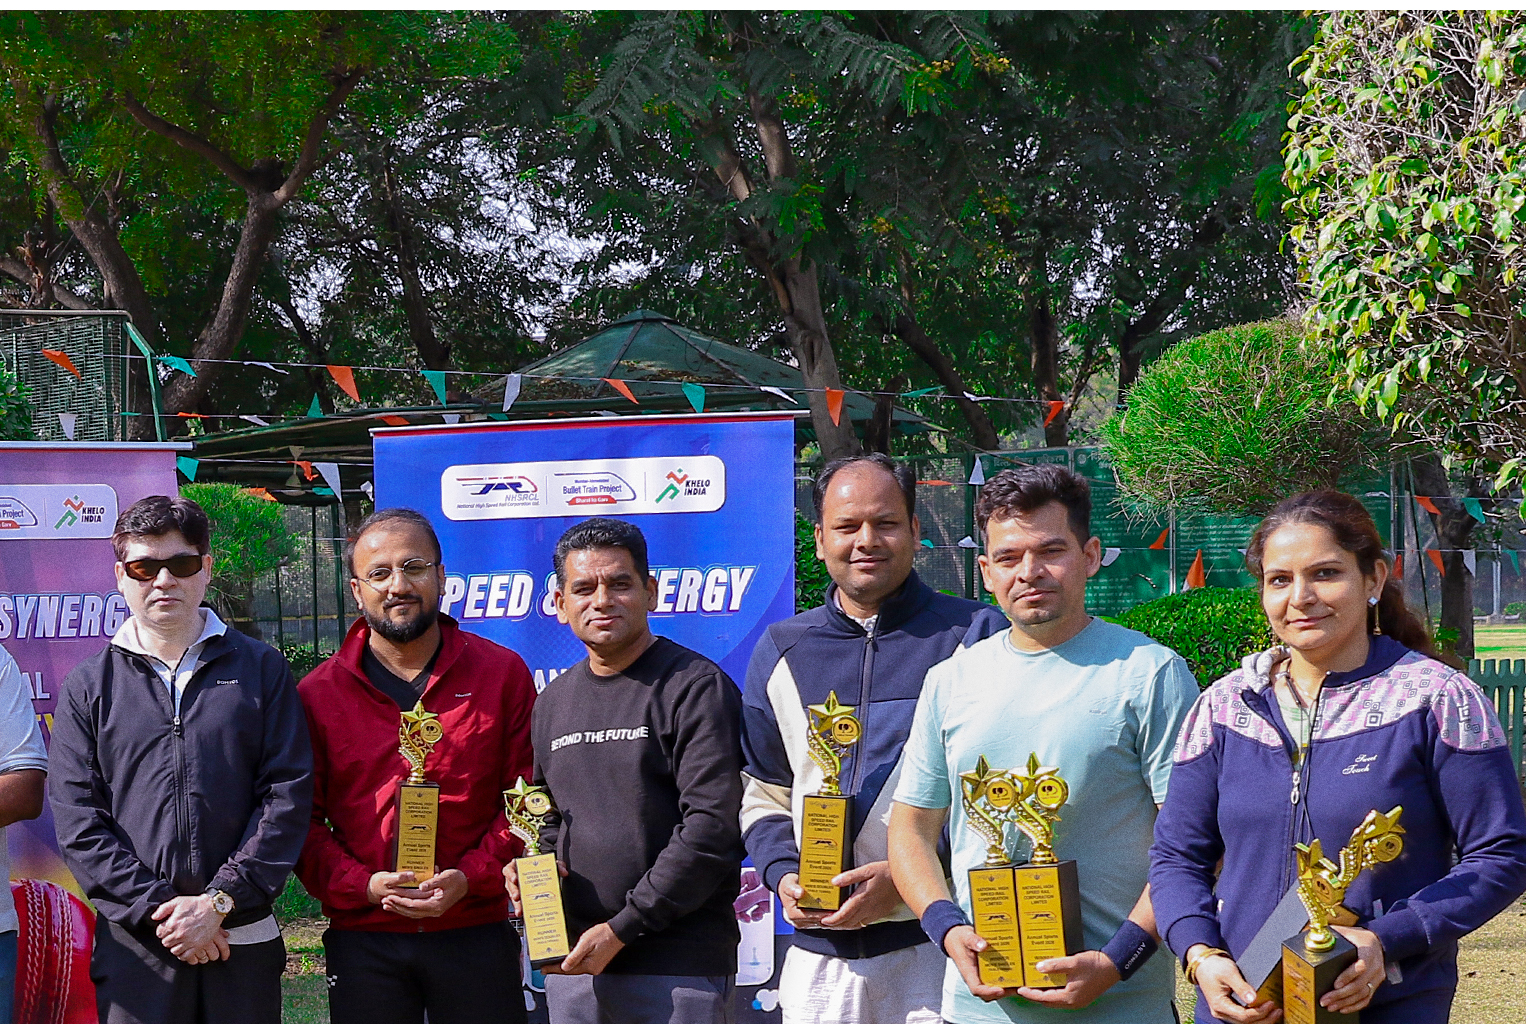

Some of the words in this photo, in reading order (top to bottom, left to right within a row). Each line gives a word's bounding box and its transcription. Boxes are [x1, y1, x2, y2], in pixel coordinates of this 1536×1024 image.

[685, 479, 711, 488] KHELO
[562, 485, 582, 495] Bullet
[582, 485, 598, 494] Train
[599, 484, 622, 495] Project
[684, 488, 707, 496] INDIA
[504, 493, 540, 502] NHSRCL
[2, 509, 24, 519] Project
[82, 507, 105, 515] KHELO
[81, 515, 102, 523] INDIA
[440, 572, 534, 619] PEED
[655, 566, 757, 613] ERGY
[550, 732, 583, 752] BEYOND
[583, 730, 605, 743] THE
[605, 725, 649, 741] FUTURE
[1354, 753, 1378, 763] Sweet
[1342, 763, 1370, 775] Touch
